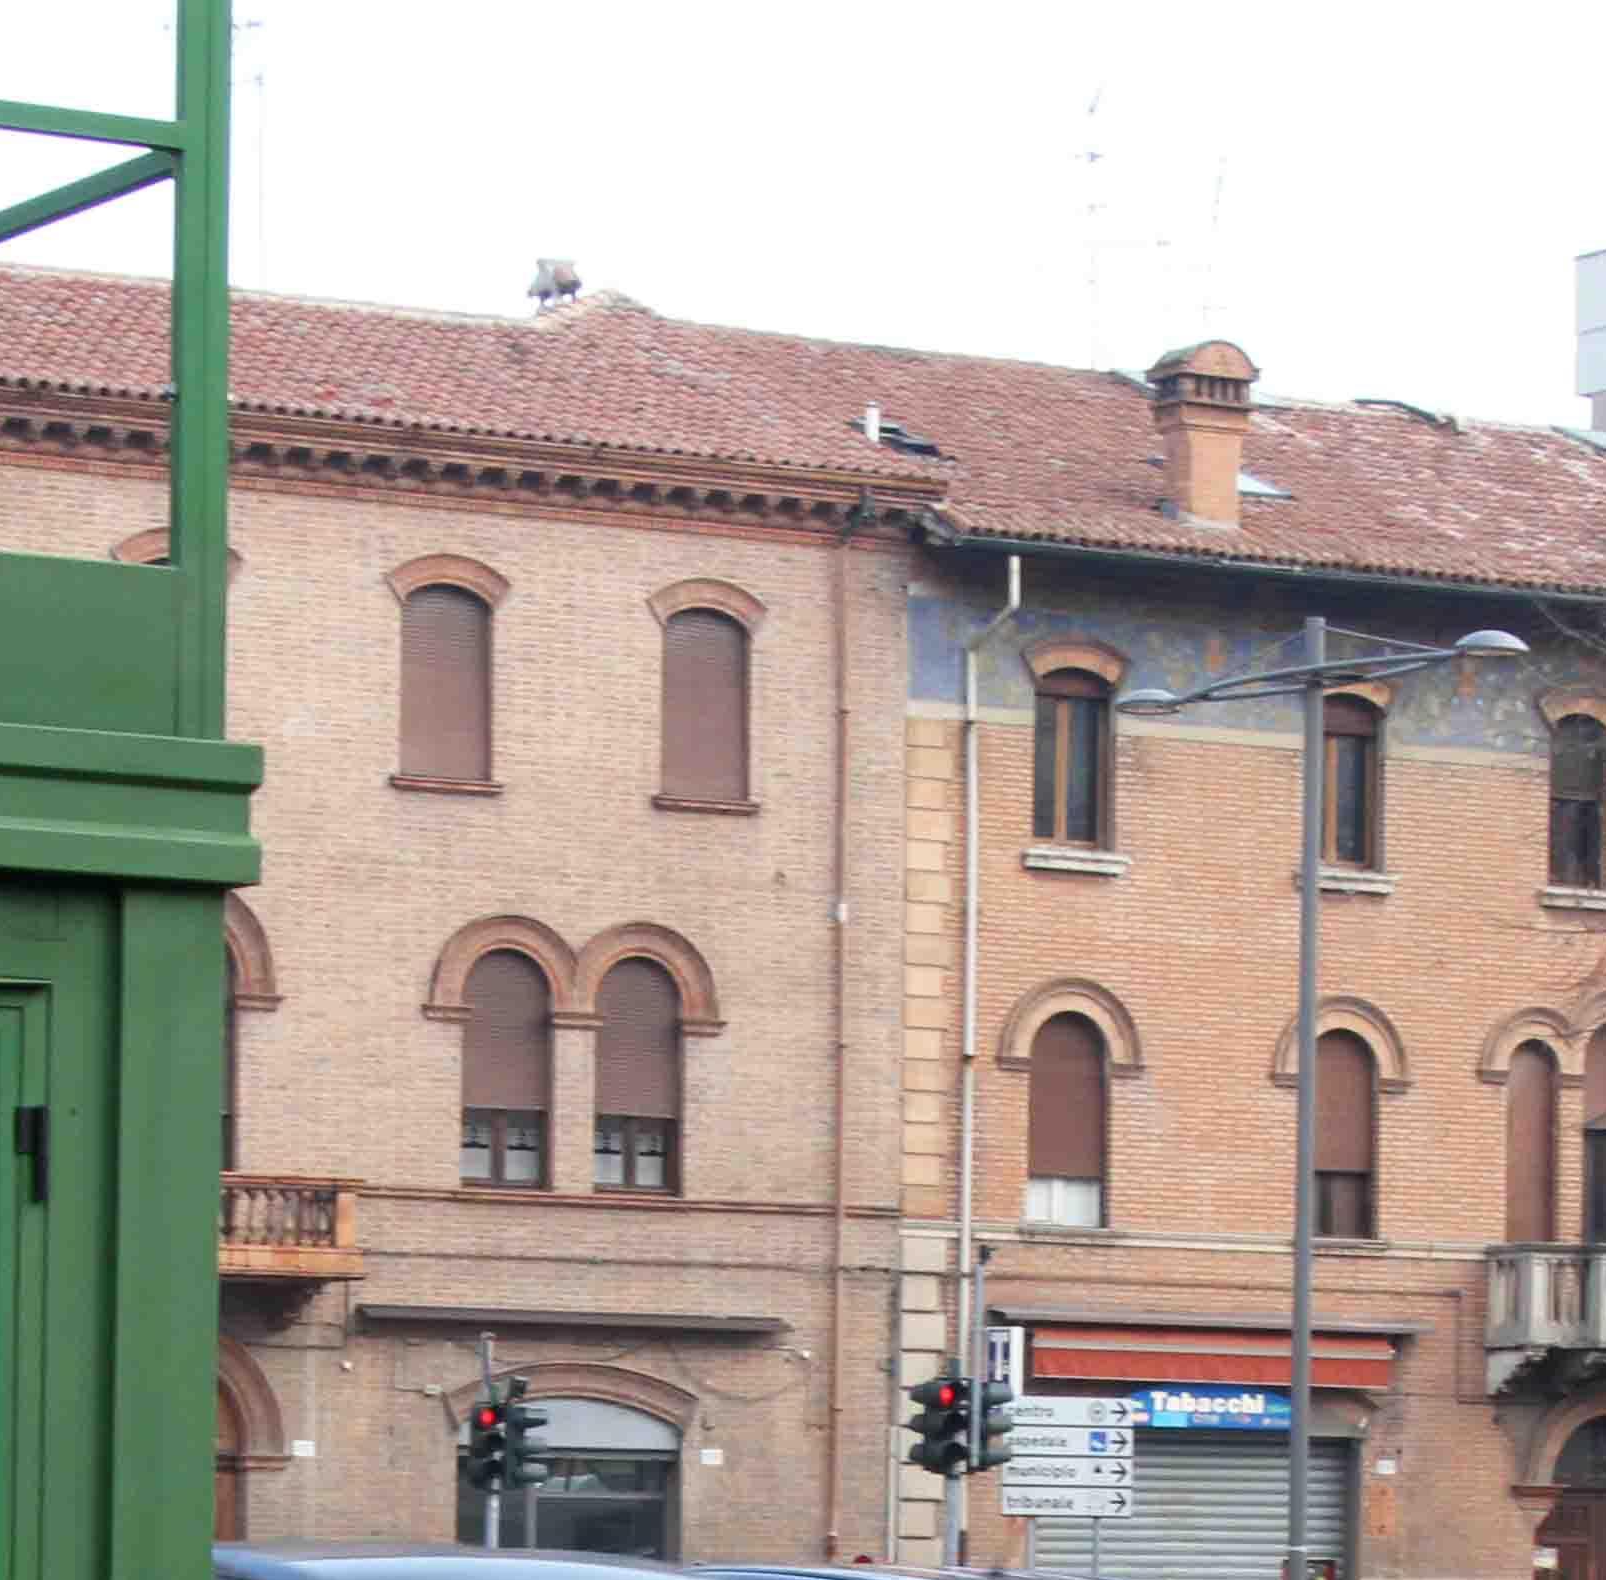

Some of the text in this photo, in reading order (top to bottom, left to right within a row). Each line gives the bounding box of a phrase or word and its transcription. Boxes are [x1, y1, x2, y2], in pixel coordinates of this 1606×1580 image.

[1150, 1391, 1265, 1414] Tabacchi
[1007, 1464, 1078, 1480] municipio
[1007, 1494, 1075, 1510] tribunale
